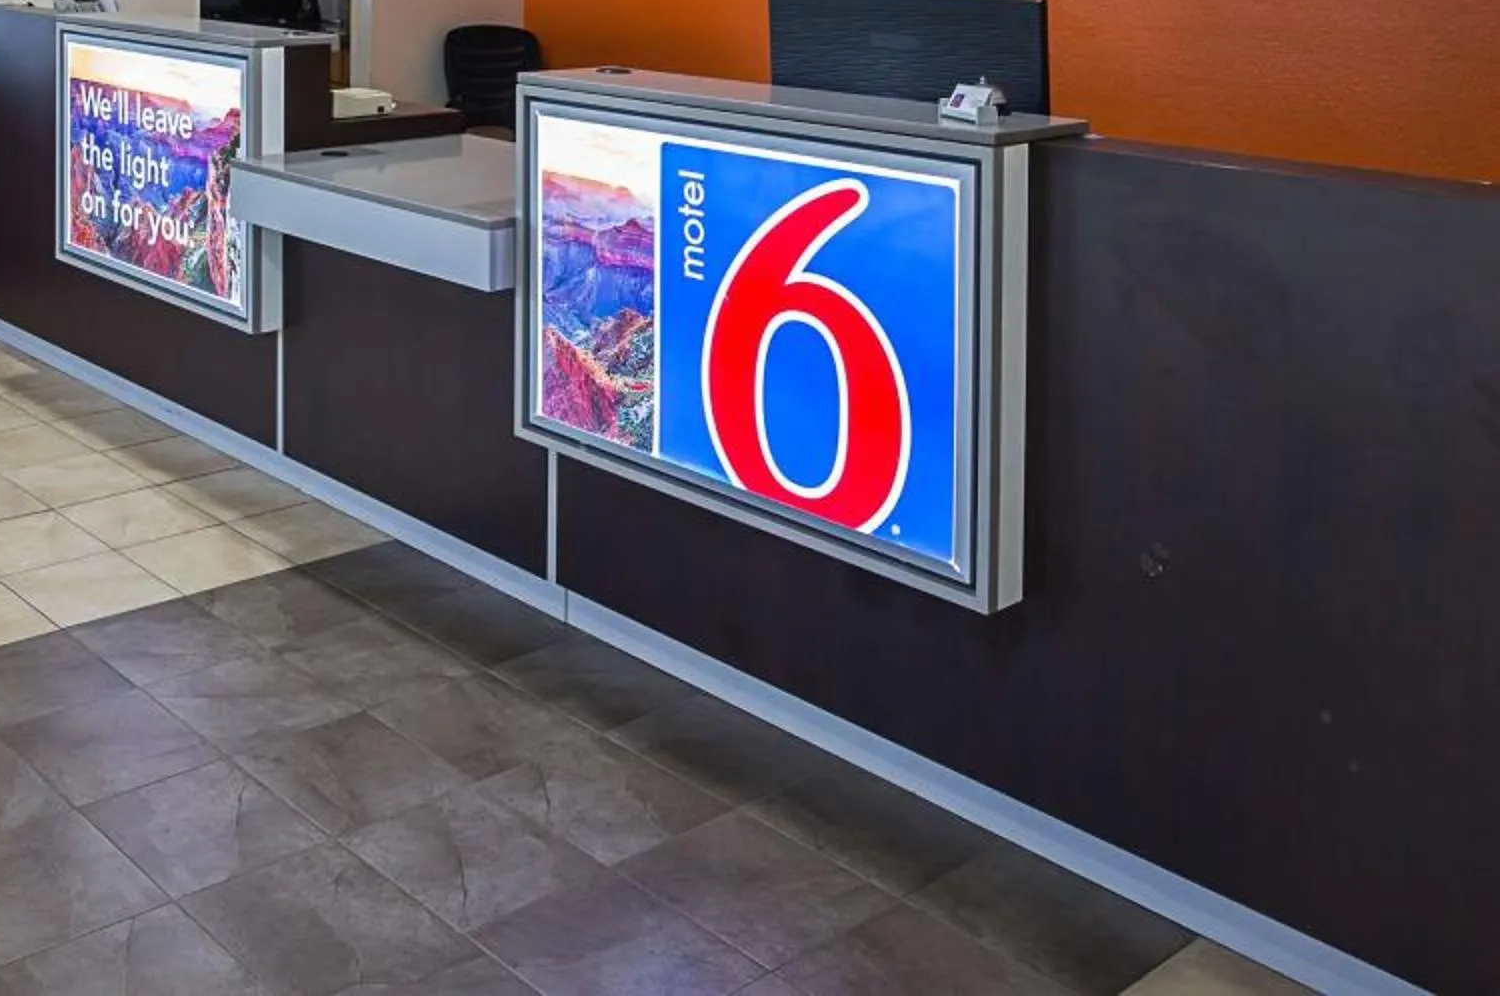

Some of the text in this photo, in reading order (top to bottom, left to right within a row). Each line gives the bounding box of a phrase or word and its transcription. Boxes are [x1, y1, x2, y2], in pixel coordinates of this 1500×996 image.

[81, 83, 193, 139] We'll leave
[81, 133, 169, 190] the light
[81, 191, 105, 219] on
[111, 190, 143, 231] for
[677, 170, 912, 535] motel 6
